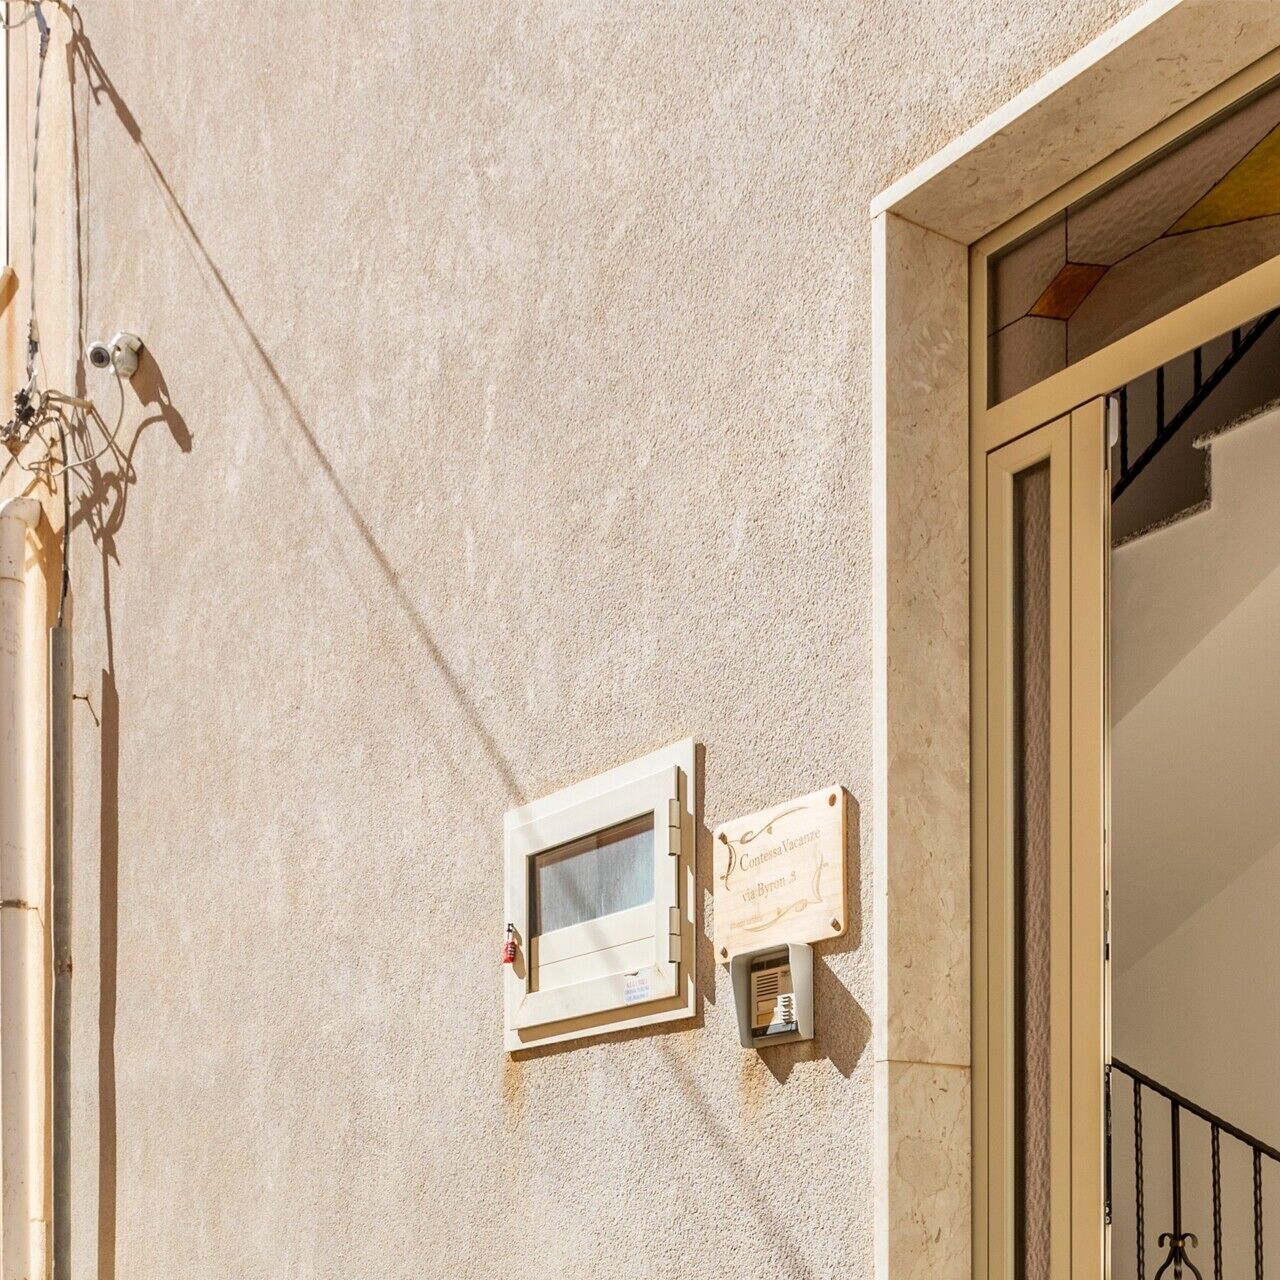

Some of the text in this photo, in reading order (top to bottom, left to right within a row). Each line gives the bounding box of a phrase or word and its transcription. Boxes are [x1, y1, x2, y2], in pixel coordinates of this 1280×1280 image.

[739, 828, 821, 872] Contessa Vacanze
[757, 876, 786, 898] Byron
